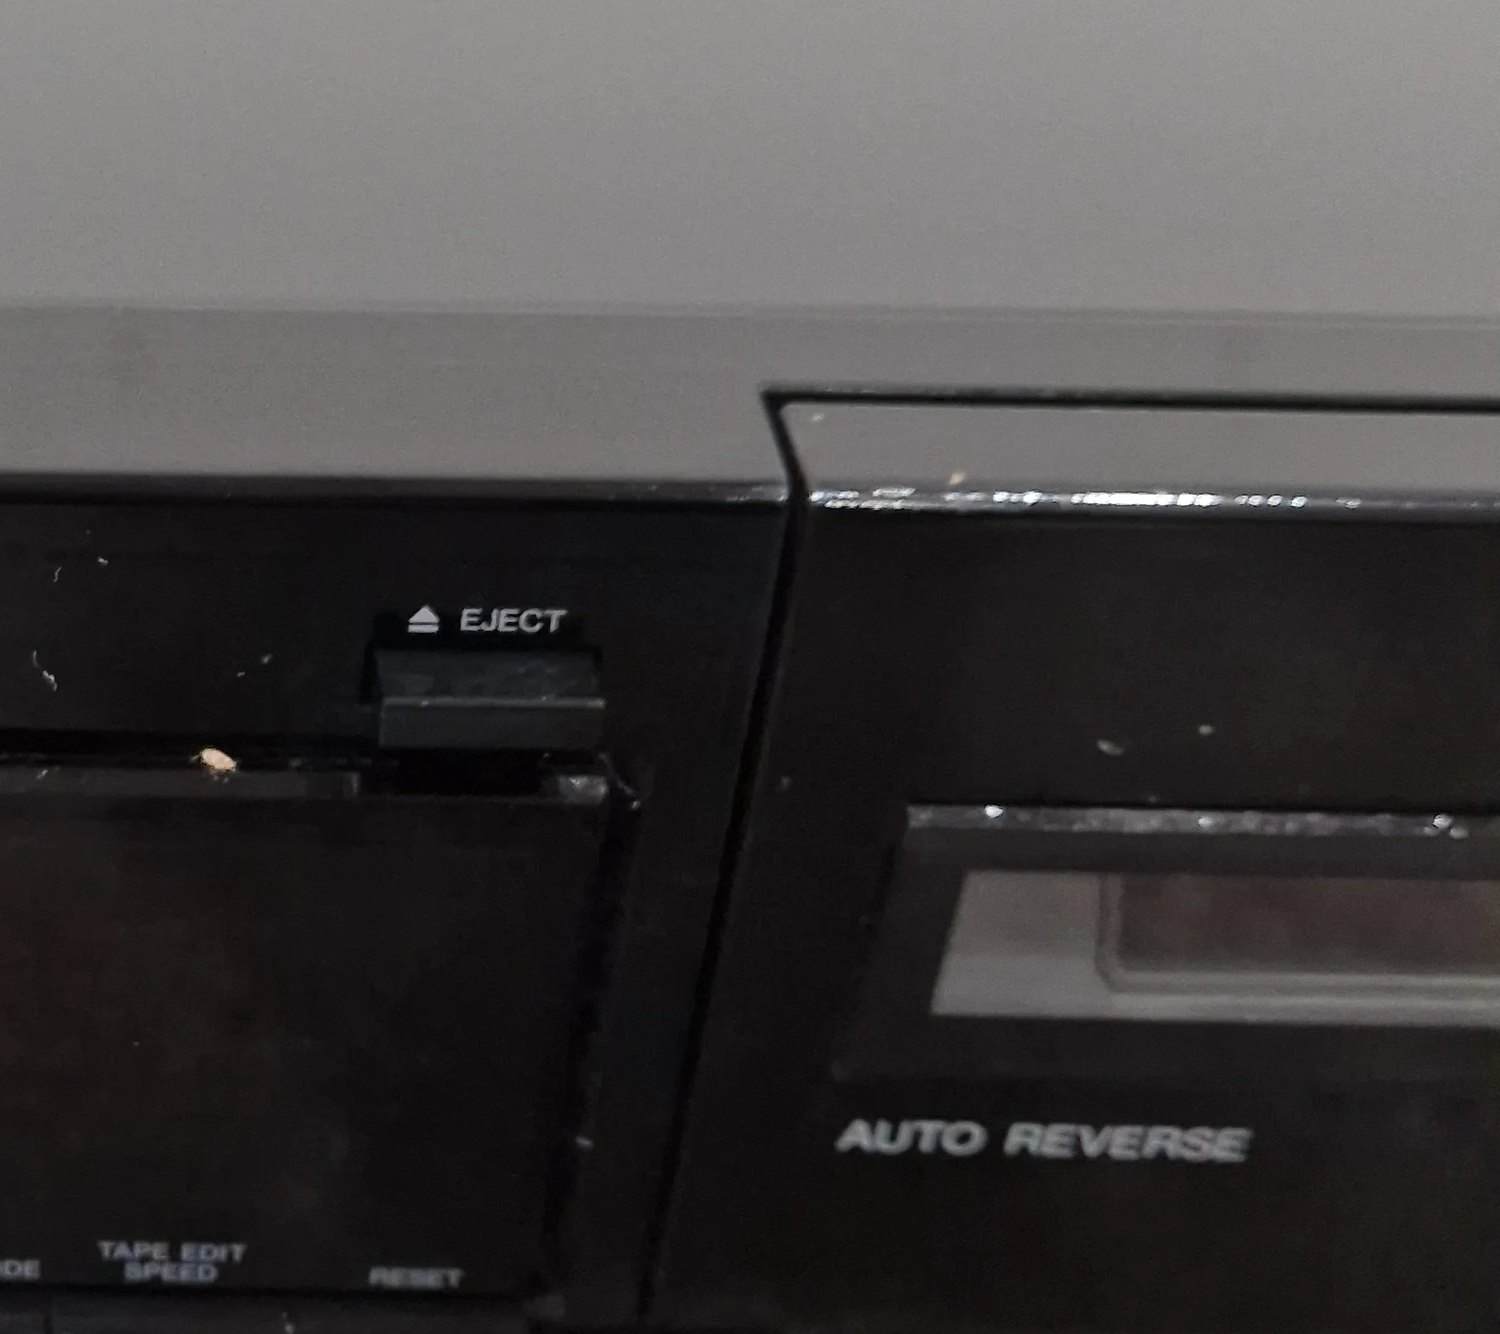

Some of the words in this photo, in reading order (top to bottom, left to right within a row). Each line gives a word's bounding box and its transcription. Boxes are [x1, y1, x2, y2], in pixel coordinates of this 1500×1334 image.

[460, 607, 567, 634] EJECT
[835, 1119, 988, 1156] AUTO
[1004, 1122, 1255, 1163] REVERSE
[99, 1241, 173, 1263] TAPE
[180, 1242, 246, 1264] EDIT
[124, 1262, 220, 1284] SPEED
[368, 1266, 465, 1290] RESET
